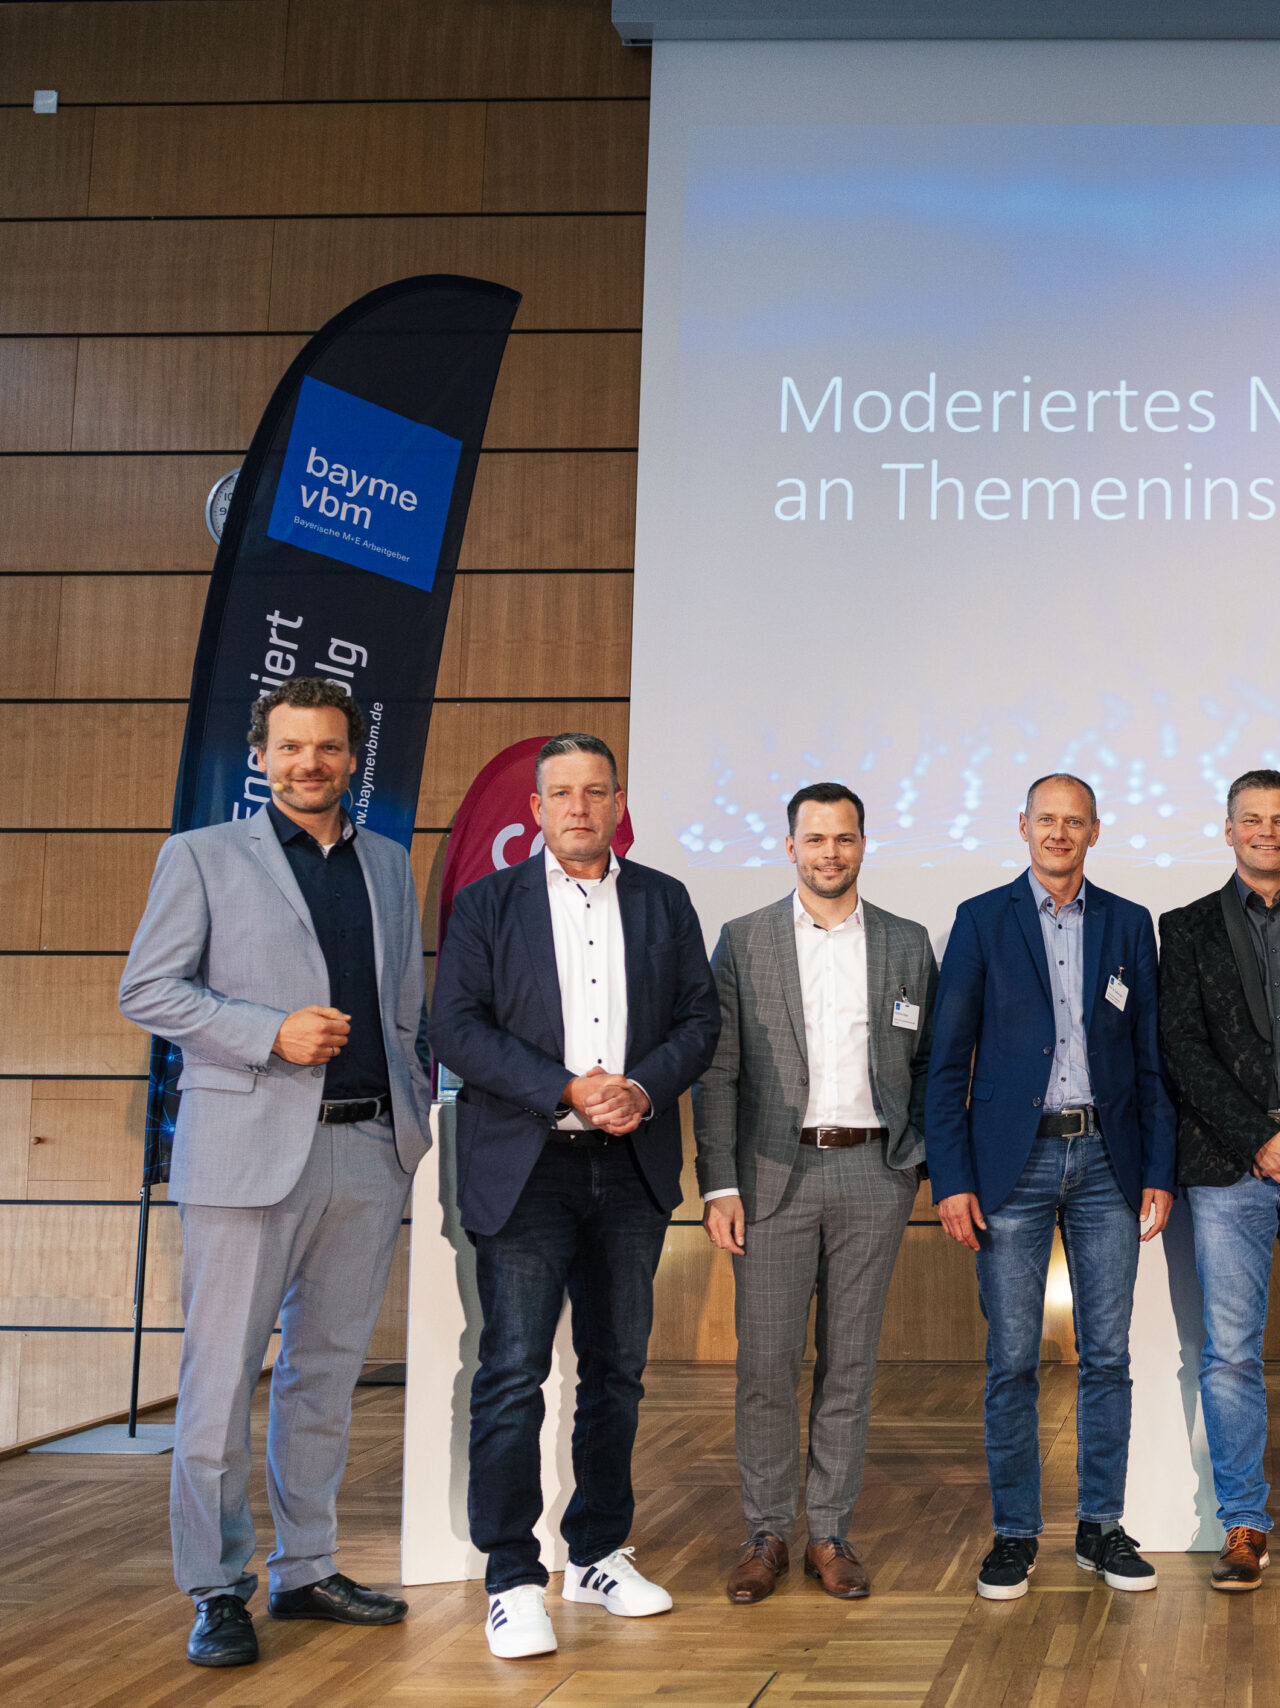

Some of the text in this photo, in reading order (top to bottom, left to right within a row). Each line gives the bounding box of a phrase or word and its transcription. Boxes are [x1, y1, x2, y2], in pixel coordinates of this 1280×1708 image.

[779, 372, 1217, 434] Moderiertes
[305, 446, 418, 512] bayme
[773, 475, 854, 522] an
[301, 484, 372, 530] vbm
[293, 515, 341, 538] Bayerische
[362, 539, 411, 563] Arbeitgeber
